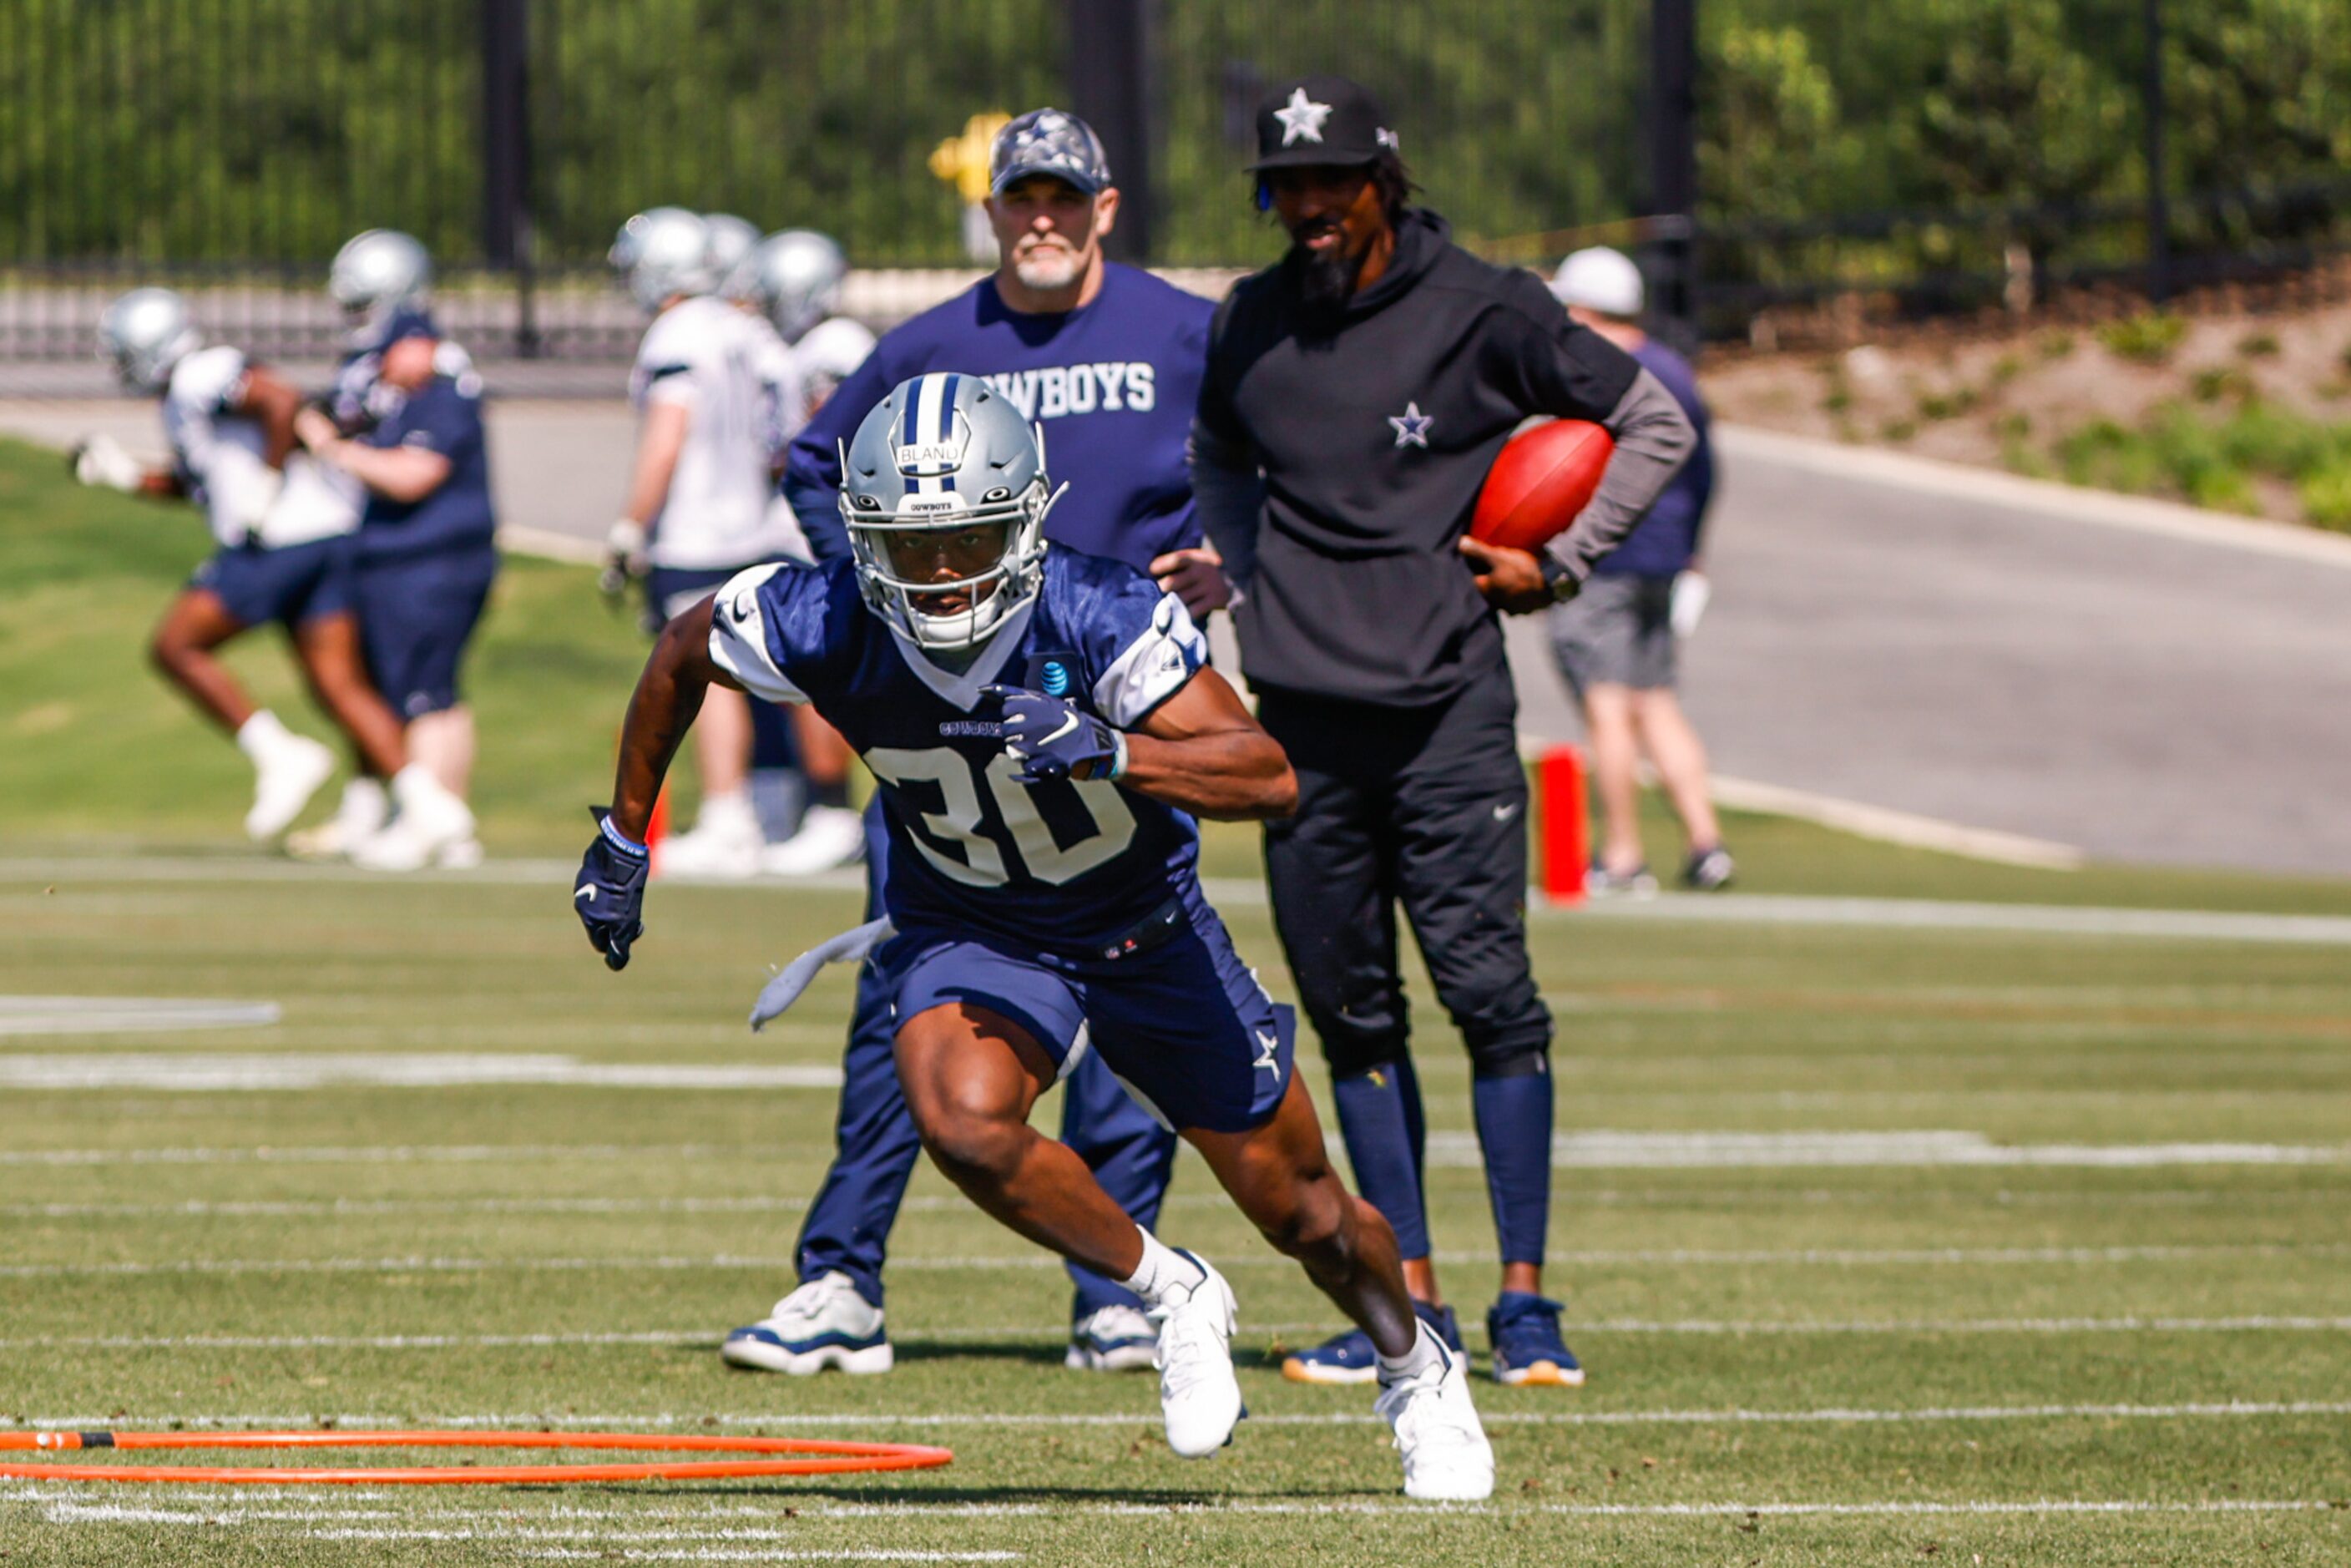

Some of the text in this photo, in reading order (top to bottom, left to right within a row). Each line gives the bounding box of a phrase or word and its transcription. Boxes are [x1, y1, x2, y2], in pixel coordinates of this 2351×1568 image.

[981, 362, 1155, 422] WBOYS
[901, 446, 959, 463] BLAND
[910, 502, 953, 512] COWBOYS
[862, 746, 1139, 888] 30
